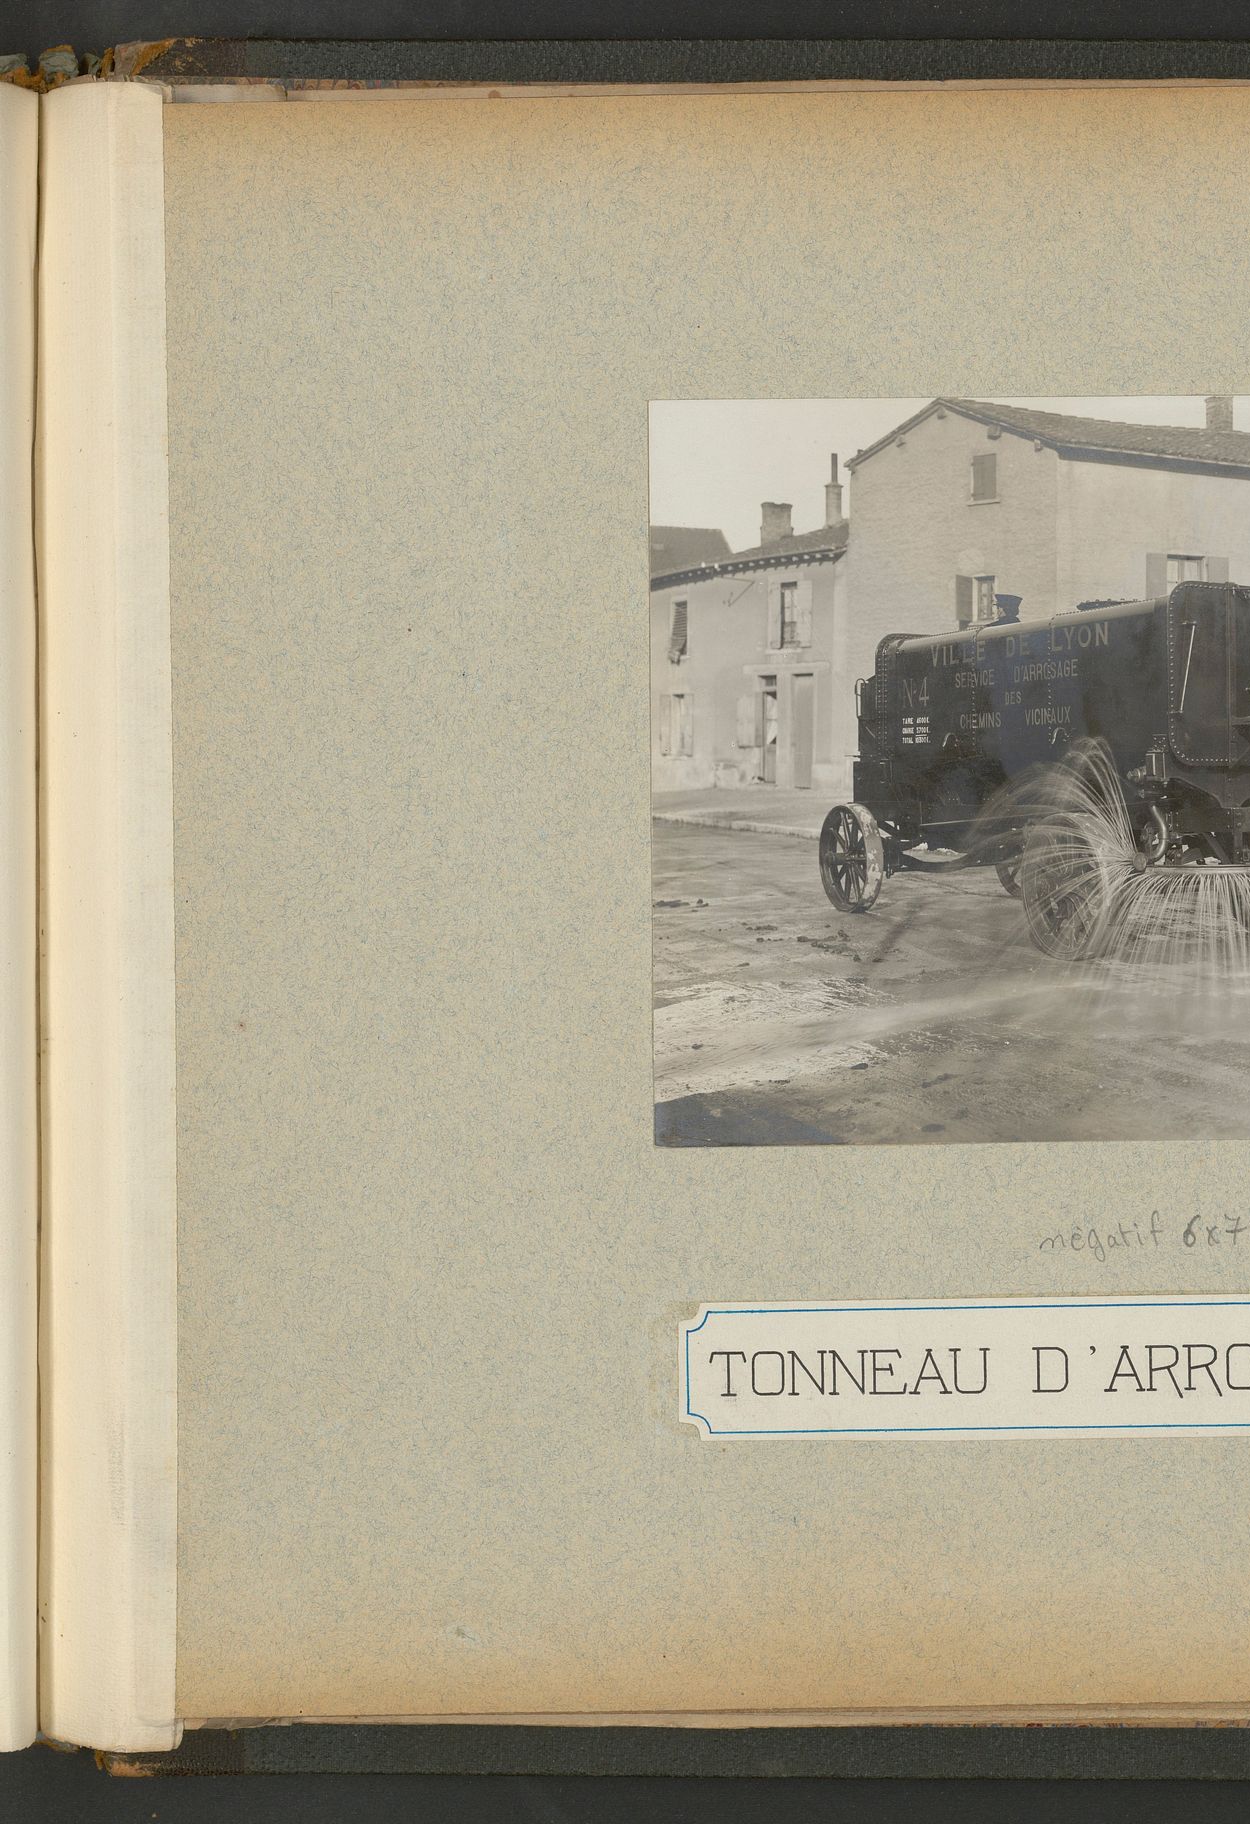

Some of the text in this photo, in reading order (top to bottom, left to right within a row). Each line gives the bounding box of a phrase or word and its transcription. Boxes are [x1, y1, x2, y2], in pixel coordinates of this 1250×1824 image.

[931, 621, 1109, 668] VILLE DE LYON
[955, 659, 1078, 688] SERVICE D'ARROSAGE
[1004, 691, 1022, 705] DES
[960, 706, 1071, 729] CHEMINS VICINAUX
[709, 1347, 990, 1397] TONNEAU
